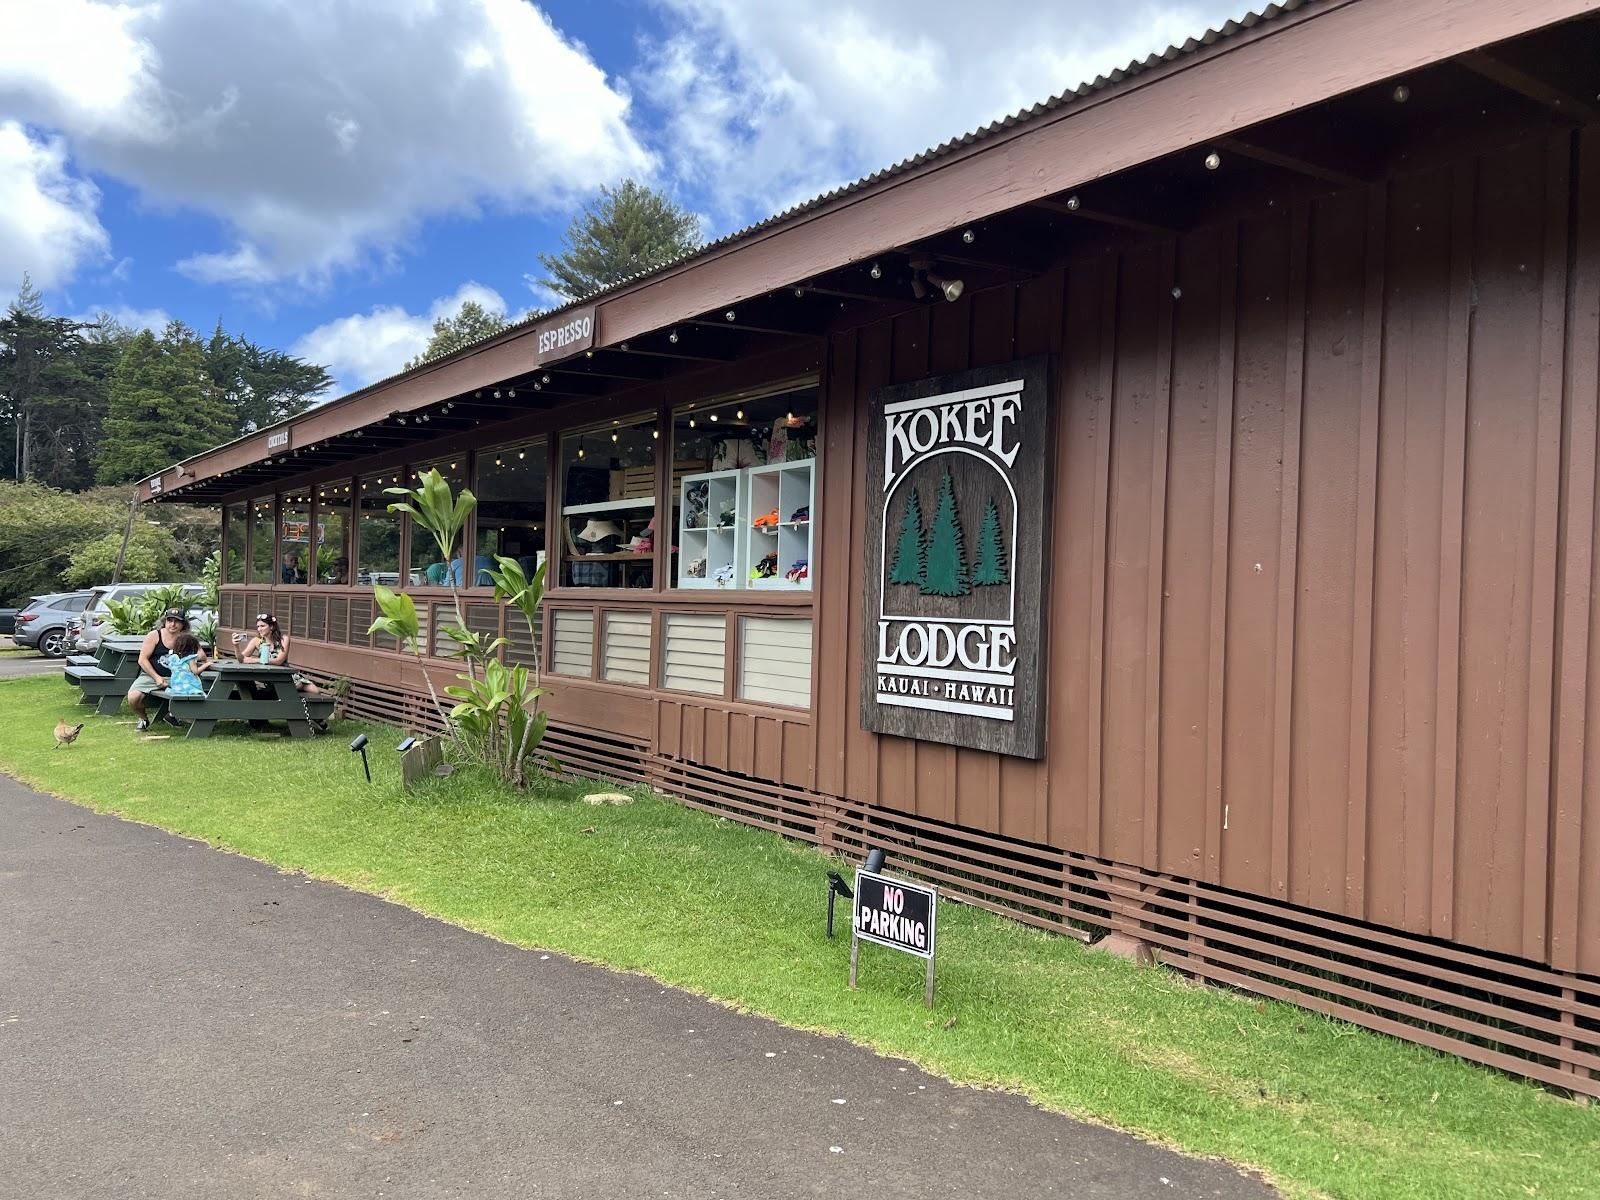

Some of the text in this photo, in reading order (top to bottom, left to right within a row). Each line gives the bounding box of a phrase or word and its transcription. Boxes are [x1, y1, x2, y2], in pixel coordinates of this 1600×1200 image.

[538, 316, 591, 354] ESPRESSO
[883, 392, 1022, 492] KOKEE
[876, 621, 1017, 675] LODGE
[877, 675, 1014, 706] KAUAI HAWAII
[883, 885, 905, 915] NO
[861, 905, 926, 949] PARKING
